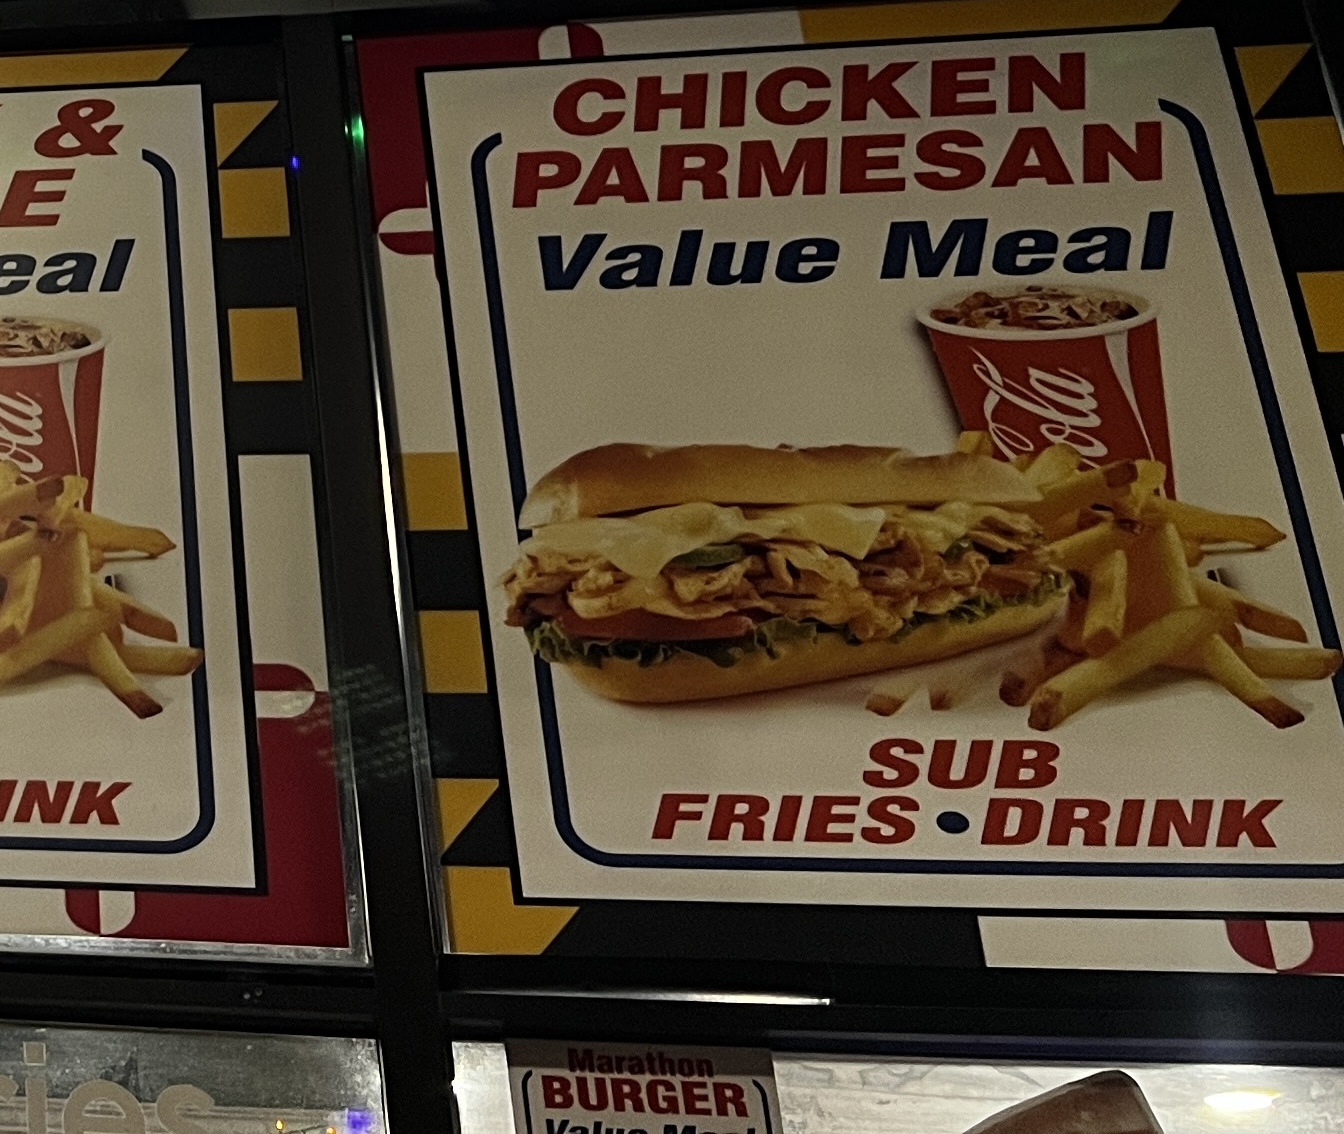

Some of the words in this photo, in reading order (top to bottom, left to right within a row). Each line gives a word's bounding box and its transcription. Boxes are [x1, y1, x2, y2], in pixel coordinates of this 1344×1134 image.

[552, 52, 1086, 136] CHICKEN
[33, 98, 124, 158] &
[512, 122, 1163, 209] PARMESAN
[536, 227, 840, 291] Value
[878, 210, 1174, 280] Meal
[862, 738, 1061, 789] SUB
[651, 793, 922, 844] FRIES
[980, 797, 1284, 848] DRINK
[567, 1048, 714, 1077] Marathon
[541, 1075, 749, 1117] BURGER
